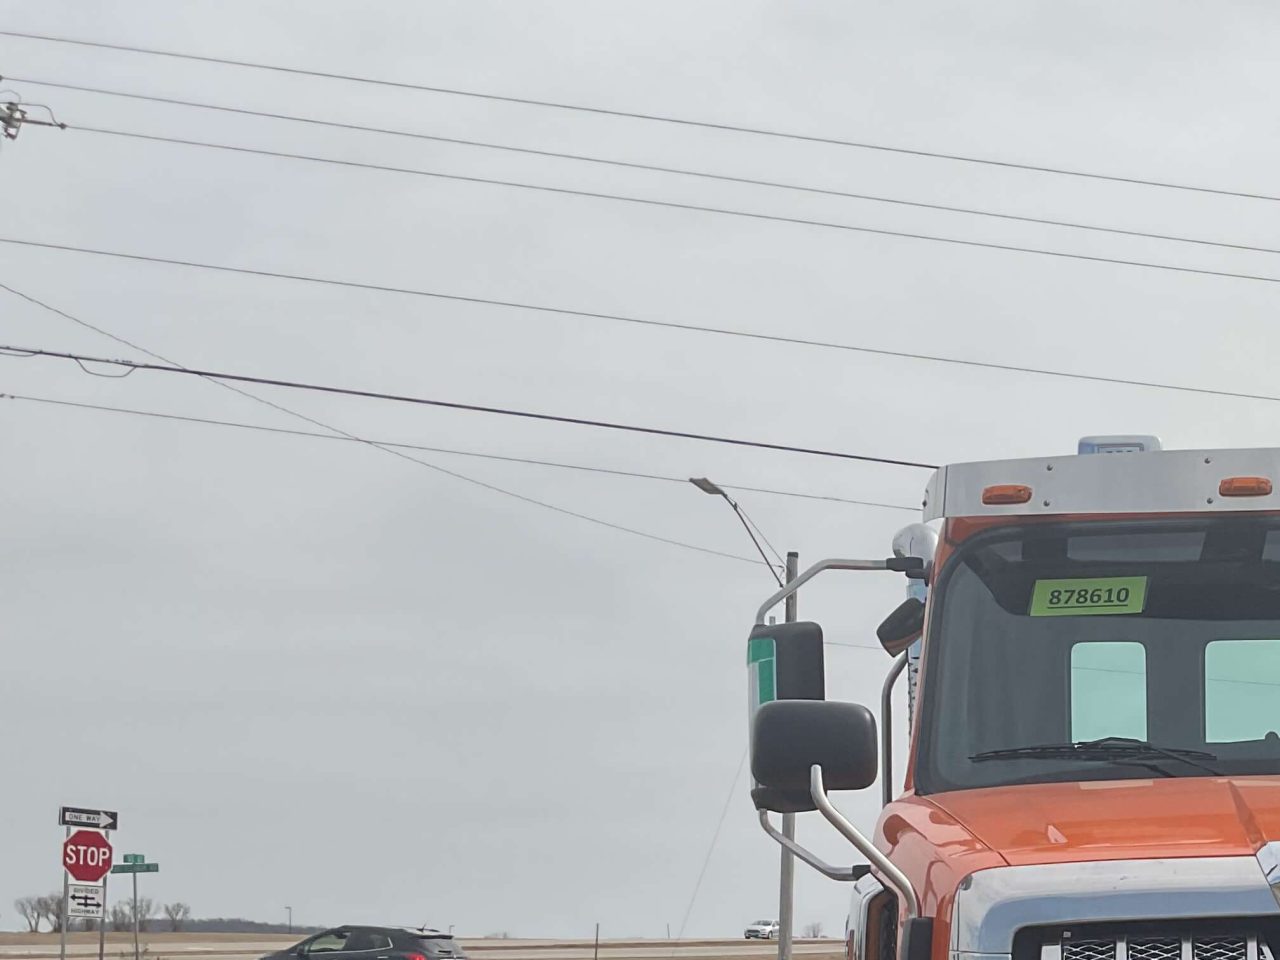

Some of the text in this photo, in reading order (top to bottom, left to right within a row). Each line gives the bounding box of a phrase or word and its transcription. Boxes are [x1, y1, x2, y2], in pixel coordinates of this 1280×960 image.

[1048, 587, 1130, 605] 878610
[68, 813, 100, 822] ONE WAY
[65, 844, 110, 867] STOP
[73, 887, 99, 895] DIVIDED
